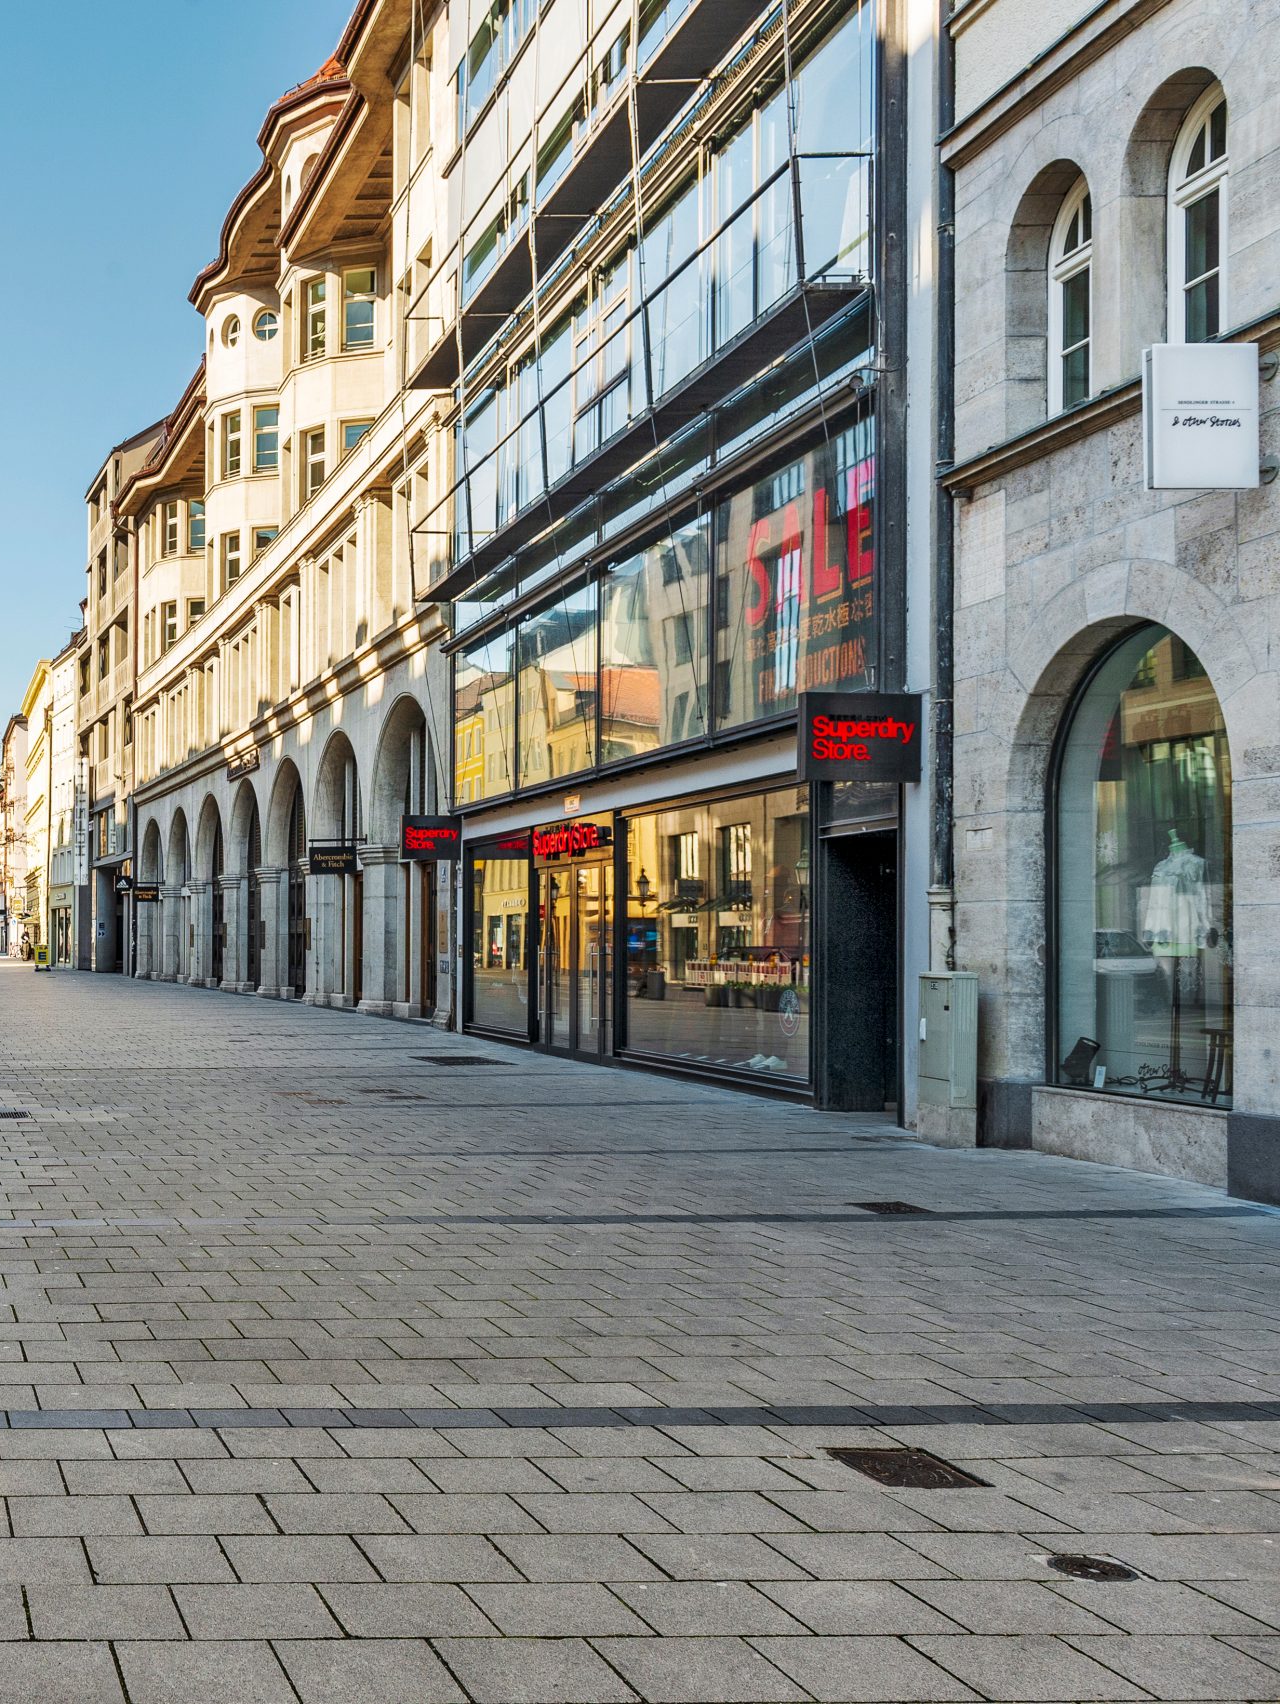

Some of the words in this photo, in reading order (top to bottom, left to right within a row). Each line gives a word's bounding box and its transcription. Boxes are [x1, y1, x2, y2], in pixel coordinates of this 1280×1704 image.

[1182, 415, 1209, 427] other
[1209, 415, 1241, 428] Stories
[745, 455, 875, 629] SALE
[812, 716, 915, 744] Superdry
[812, 738, 872, 760] Store.
[405, 826, 459, 841] Superdry
[533, 823, 573, 861] Superdry
[573, 823, 599, 849] Store.
[328, 860, 345, 868] Fitch
